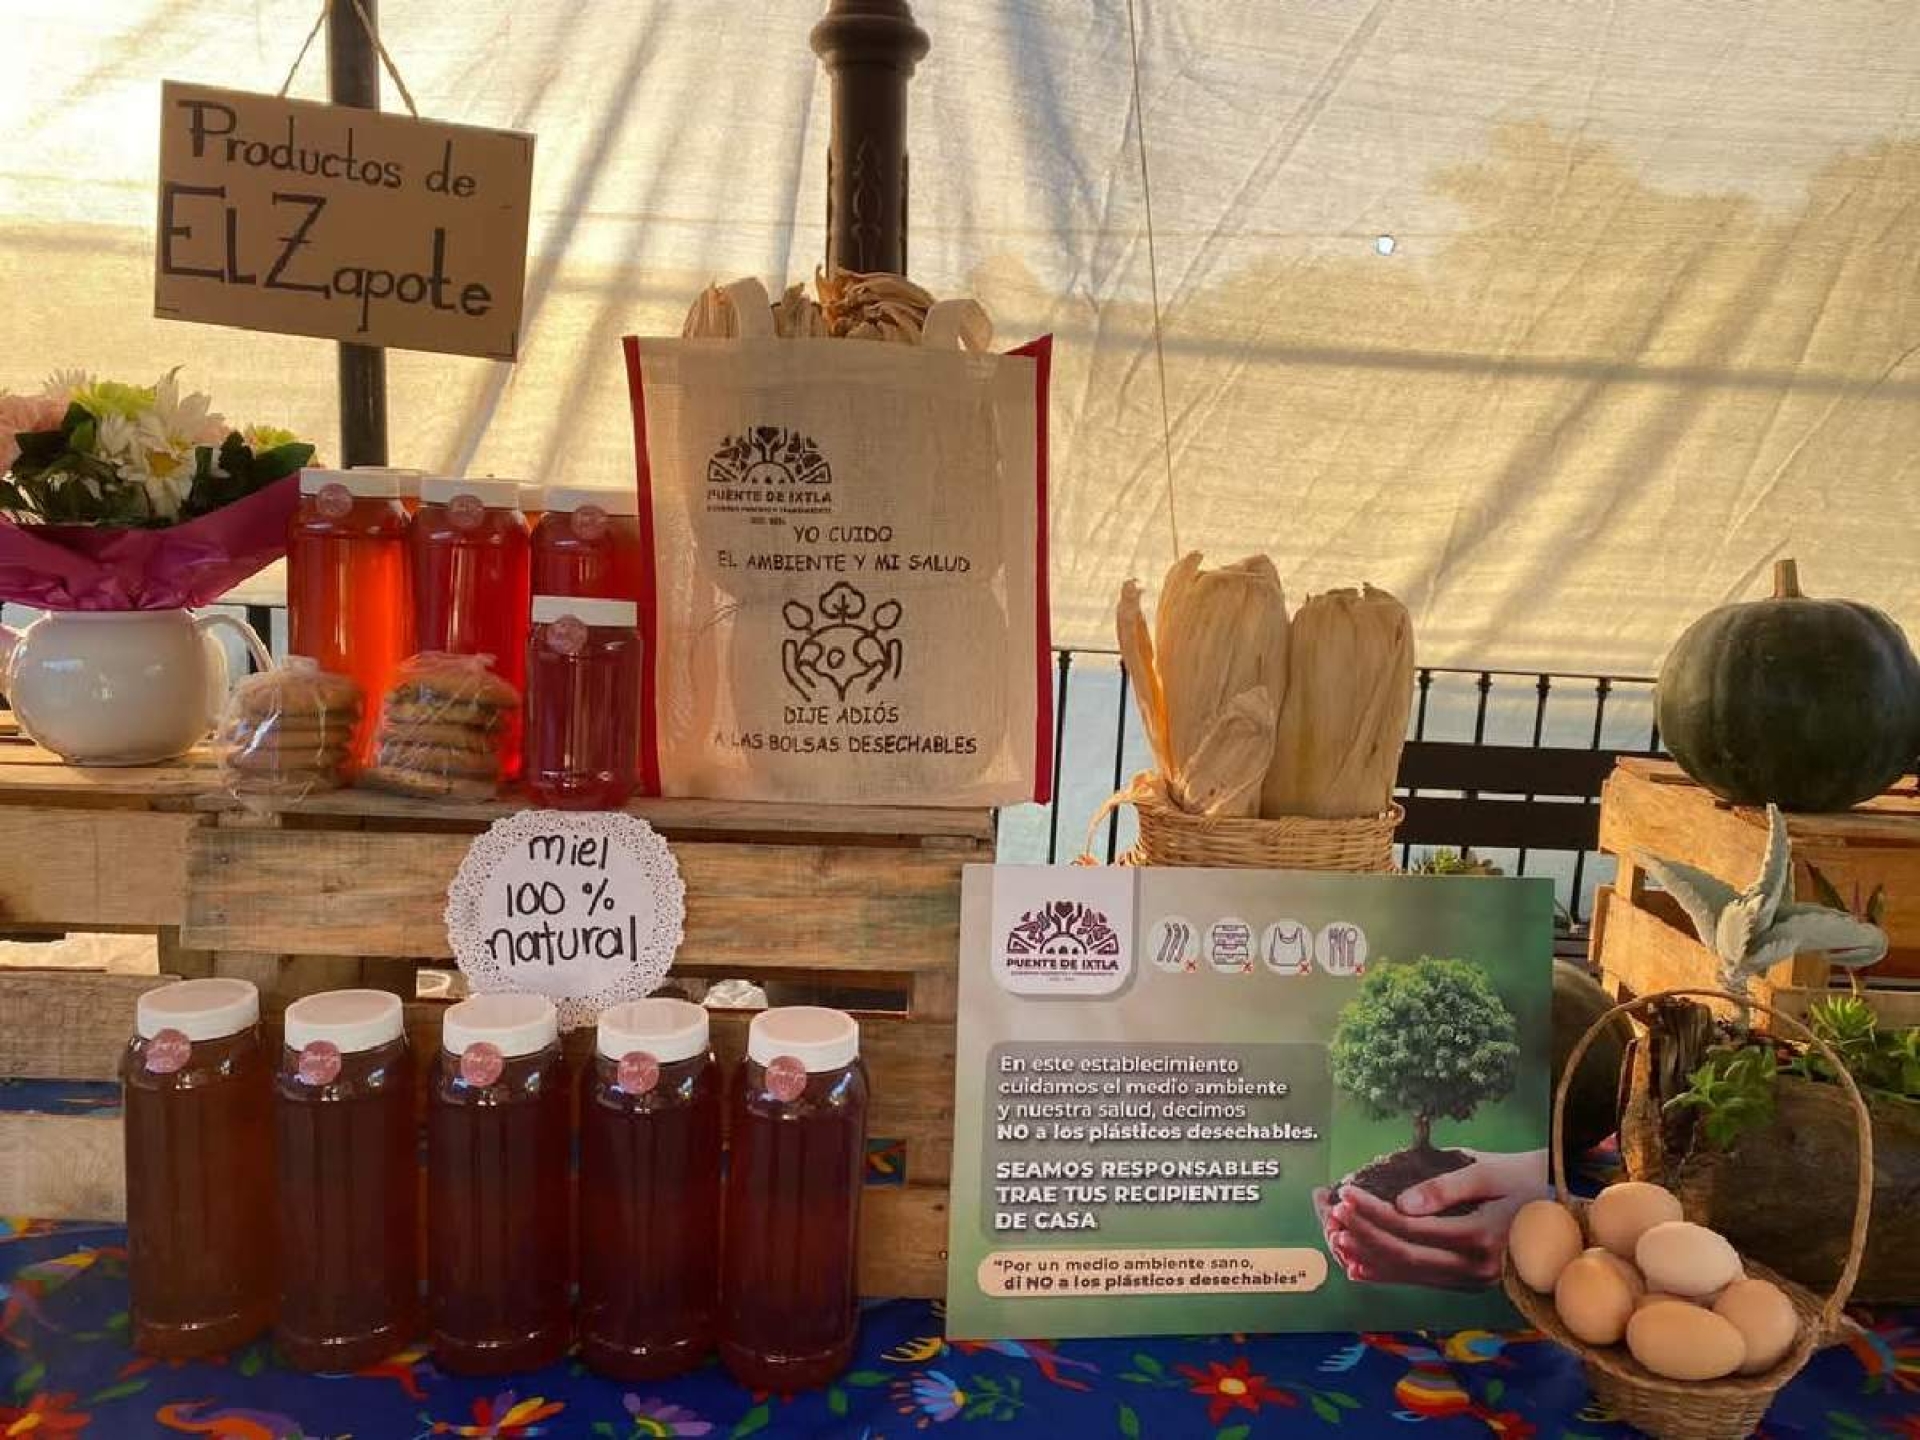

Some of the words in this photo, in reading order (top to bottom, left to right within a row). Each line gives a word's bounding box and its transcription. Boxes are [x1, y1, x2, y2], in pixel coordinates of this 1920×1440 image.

[177, 100, 402, 189] Productos
[425, 140, 477, 198] de
[265, 192, 491, 333] Zapote
[707, 489, 761, 501] PUENTE
[766, 490, 784, 502] DE
[788, 491, 832, 503] IXTLA
[793, 526, 819, 542] YO
[828, 526, 893, 542] CUIDO
[717, 550, 737, 567] EL
[747, 554, 846, 571] AMBIENTE
[854, 554, 866, 571] Y
[875, 554, 900, 571] MI
[908, 554, 971, 572] SALUD
[784, 706, 829, 725] DIJE
[837, 702, 899, 724] ADIÓS
[732, 732, 763, 749] LAS
[769, 734, 839, 753] BOLSAS
[849, 735, 977, 754] DESECHABLES
[506, 881, 565, 917] 100
[582, 878, 615, 916] %
[485, 915, 638, 965] natural
[1006, 958, 1057, 969] PUENTE
[1060, 959, 1078, 970] DE
[1082, 960, 1119, 970] IXTLA
[1000, 1056, 1025, 1072] En
[1033, 1056, 1075, 1072] este
[1081, 1056, 1239, 1073] establecimiento
[998, 1077, 1098, 1094] cuidamos
[1103, 1077, 1121, 1094] el
[1126, 1077, 1188, 1094] medio
[1195, 1077, 1288, 1094] ambiente
[997, 1103, 1010, 1121] y
[1017, 1103, 1092, 1118] nuestra
[1099, 1101, 1156, 1120] salud,
[1163, 1101, 1246, 1118] decimos
[997, 1124, 1029, 1140] NO
[1036, 1127, 1046, 1140] a
[1053, 1124, 1084, 1140] los
[1089, 1122, 1182, 1144] plásticos
[1187, 1123, 1318, 1140] desechables.
[996, 1161, 1094, 1178] SEAMOS
[1101, 1160, 1280, 1178] RESPONSABLES
[995, 1186, 1057, 1203] TRAE
[1063, 1186, 1107, 1203] TUS
[1115, 1185, 1260, 1202] RECIPIENTES
[994, 1212, 1027, 1229] DE
[1034, 1211, 1097, 1229] CASA
[1038, 1261, 1059, 1271] un
[1066, 1257, 1119, 1271] medio
[1124, 1257, 1204, 1270] ambiente
[1210, 1259, 1254, 1271] sano,
[1004, 1275, 1022, 1290] di
[1026, 1277, 1053, 1290] NO
[1058, 1279, 1069, 1289] a
[1073, 1275, 1100, 1289] los
[1105, 1273, 1185, 1292] plásticos
